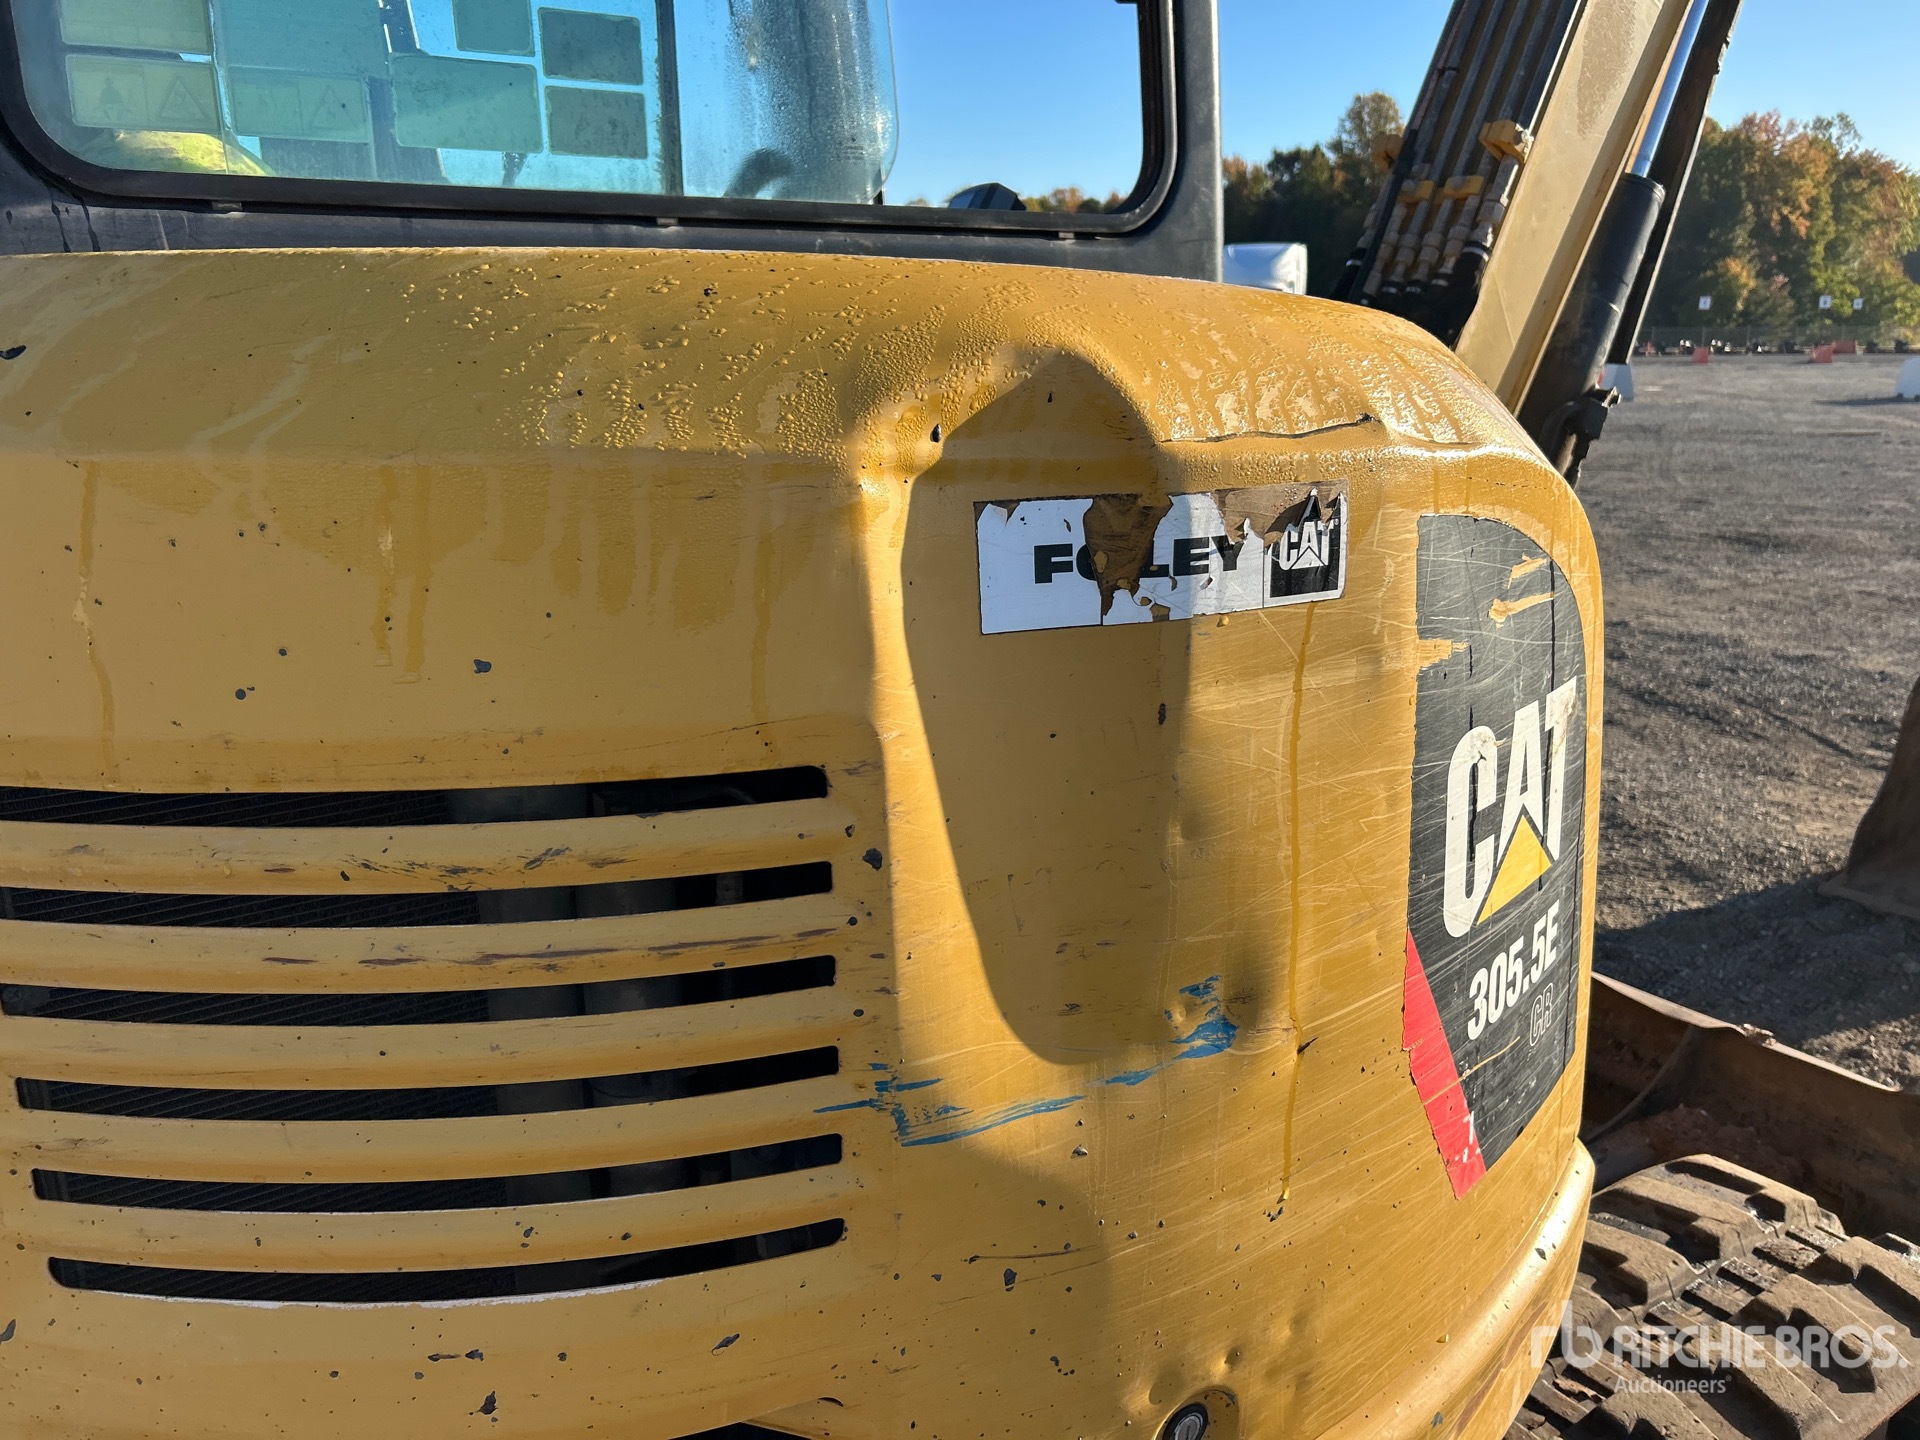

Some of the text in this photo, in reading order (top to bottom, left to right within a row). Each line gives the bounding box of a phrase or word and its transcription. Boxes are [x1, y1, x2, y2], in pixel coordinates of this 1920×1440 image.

[1279, 520, 1335, 571] CAT
[1443, 675, 1577, 938] CAT
[1467, 899, 1560, 1040] 305.5E
